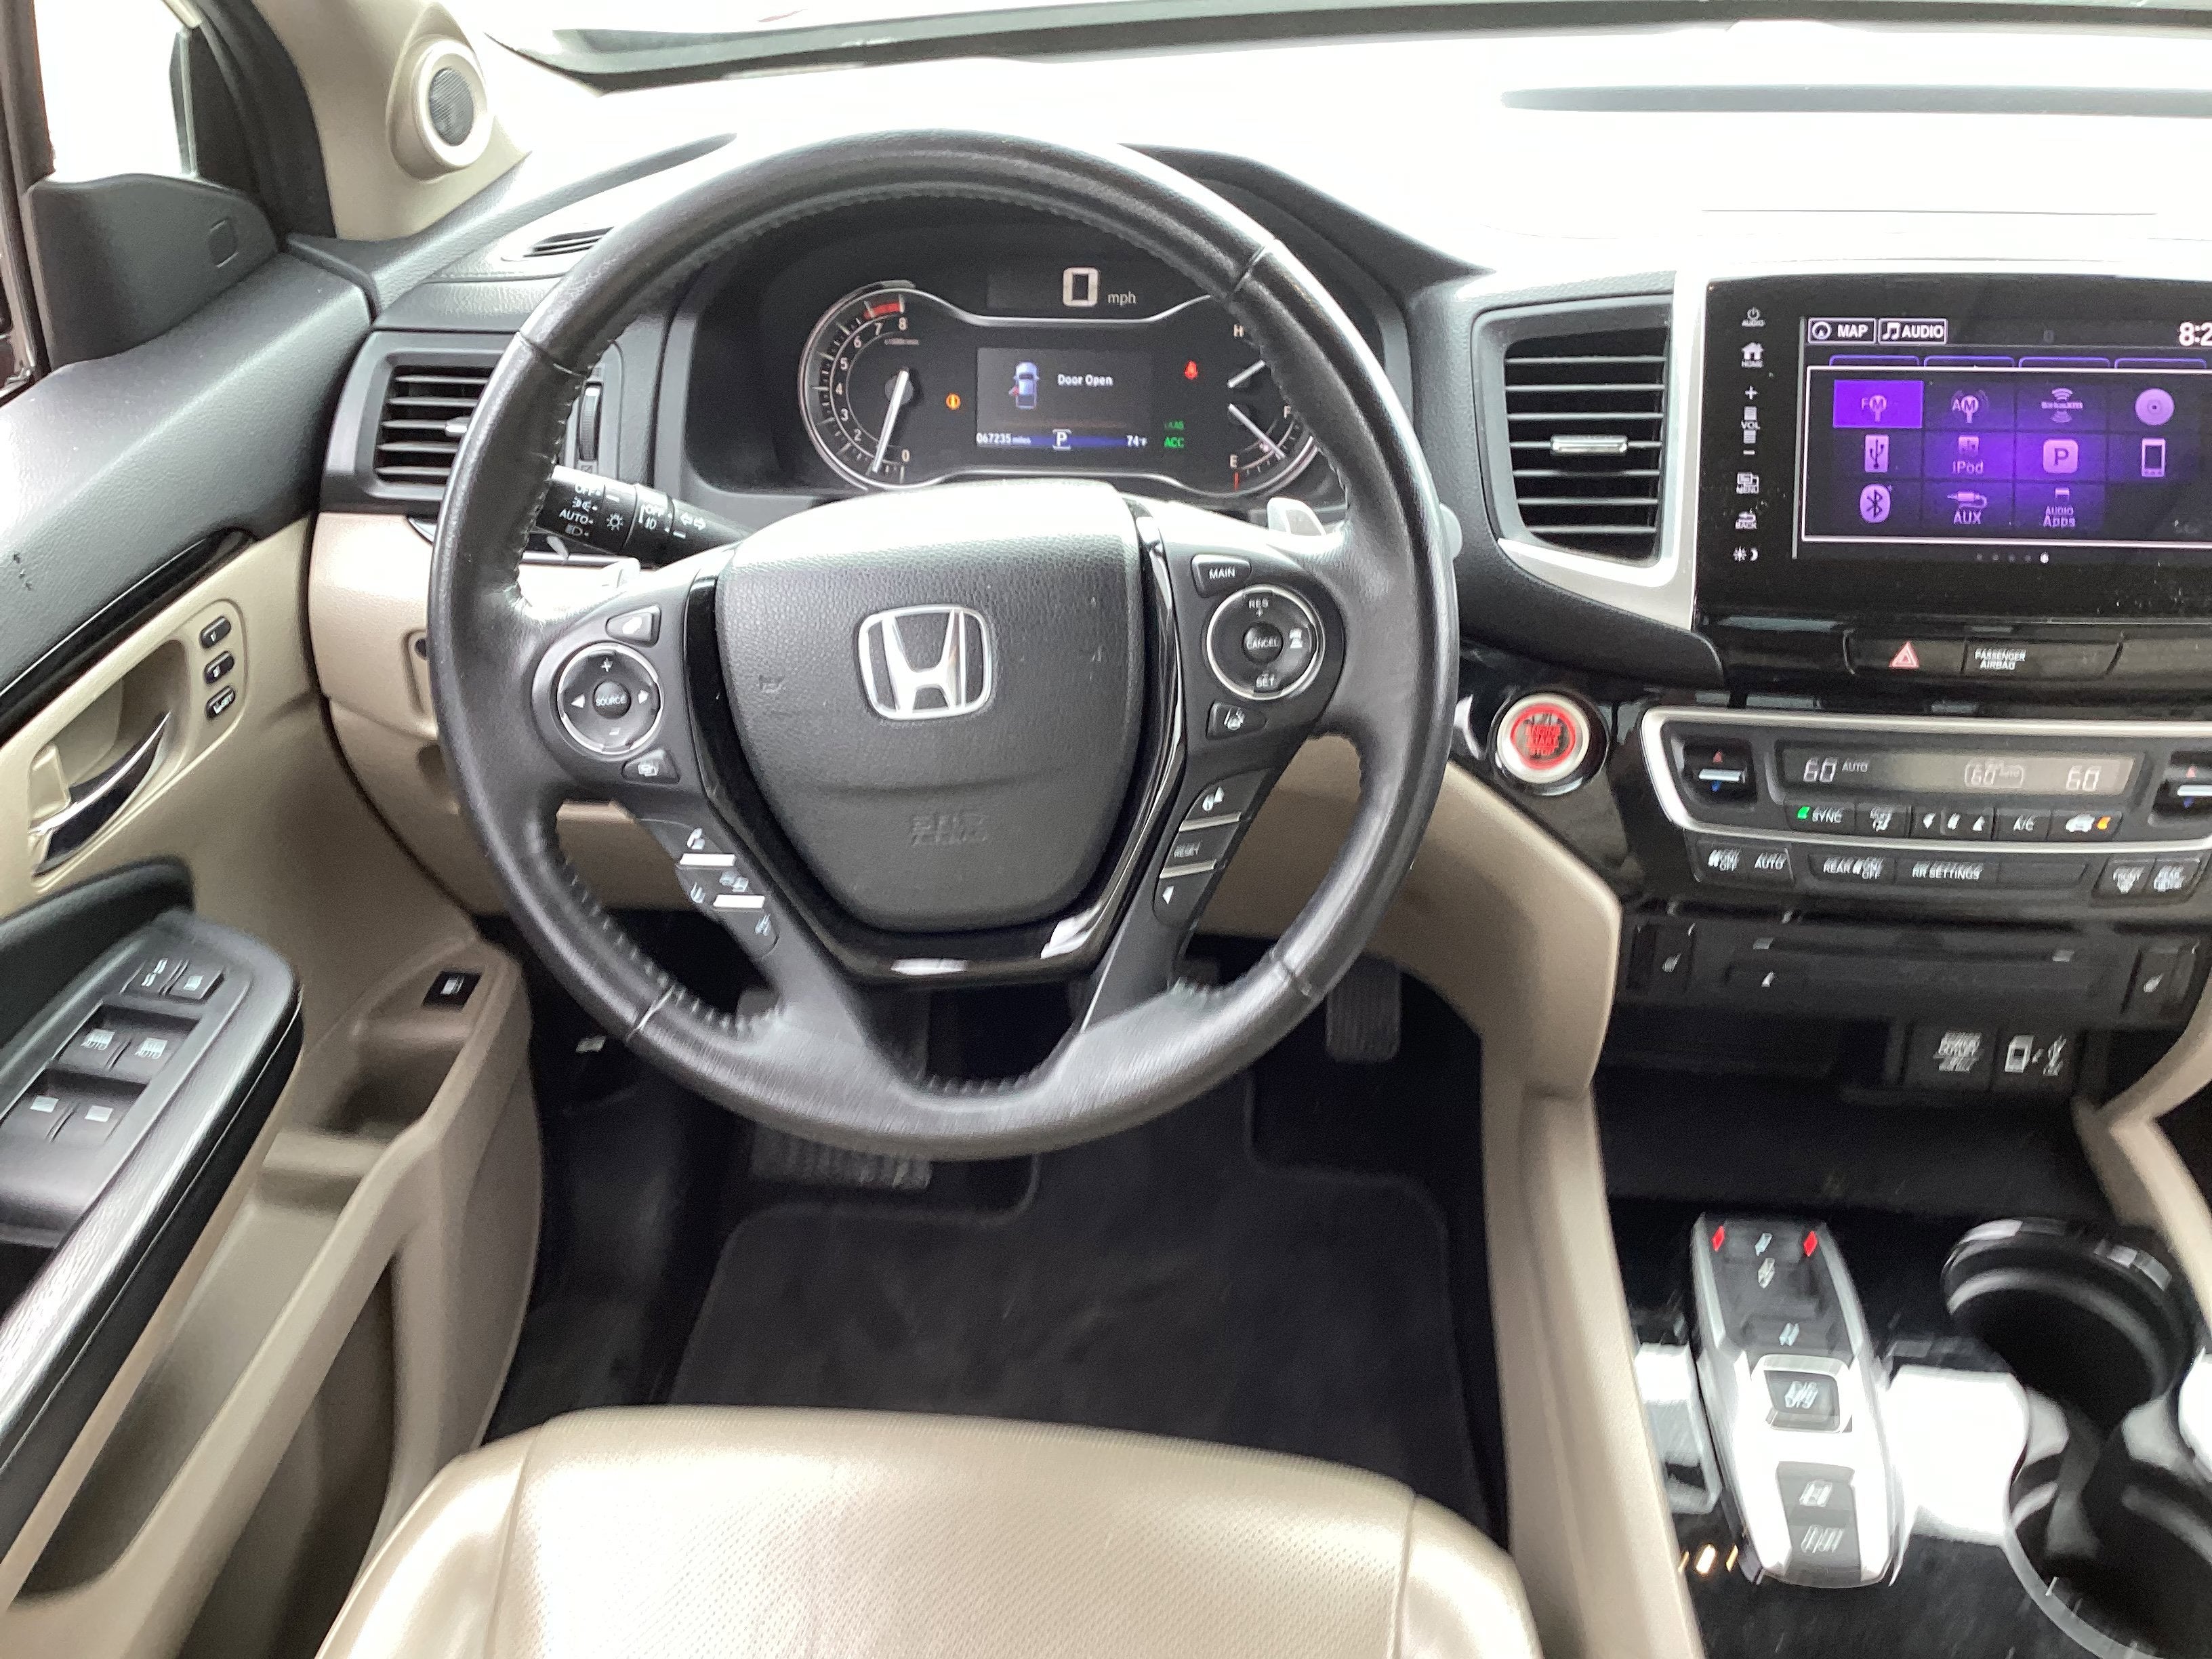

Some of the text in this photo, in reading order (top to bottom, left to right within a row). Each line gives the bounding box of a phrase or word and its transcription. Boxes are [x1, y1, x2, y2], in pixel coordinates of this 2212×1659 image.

[1107, 291, 1136, 306] mph
[874, 321, 884, 335] 7
[899, 316, 908, 331] 8
[1233, 323, 1245, 337] H
[1837, 324, 1869, 338] MAP
[1901, 325, 1944, 339] AUDIO
[2179, 321, 2212, 346] 8:2
[853, 335, 862, 348] 6
[840, 356, 848, 370] 5
[1057, 373, 1114, 388] Door Open
[834, 382, 844, 395] 4
[840, 407, 848, 422] 3
[1740, 420, 1761, 430] VOL
[852, 428, 862, 442] 2
[976, 432, 1012, 445] 067235
[1056, 431, 1069, 447] P
[1164, 436, 1185, 449] ACC
[1952, 460, 1985, 474] iPod
[575, 485, 595, 497] OFF
[559, 508, 589, 525] AUTO
[1952, 510, 1982, 525] AUX
[2042, 516, 2076, 529] Apps
[1208, 568, 1236, 579] MAIN
[1246, 638, 1279, 651] CANCEL
[1975, 648, 2027, 661] PASSENGER
[1980, 659, 2017, 670] AIRBAG
[596, 694, 627, 706] SOURCE
[1803, 758, 1870, 783] 60 AUTO
[2066, 765, 2102, 792] 60
[1811, 808, 1844, 823] SYNC
[2013, 815, 2035, 831] A/C
[1755, 853, 1788, 870] AUTO
[1823, 857, 1854, 874] REAR
[1929, 862, 1984, 880] SETTINGS
